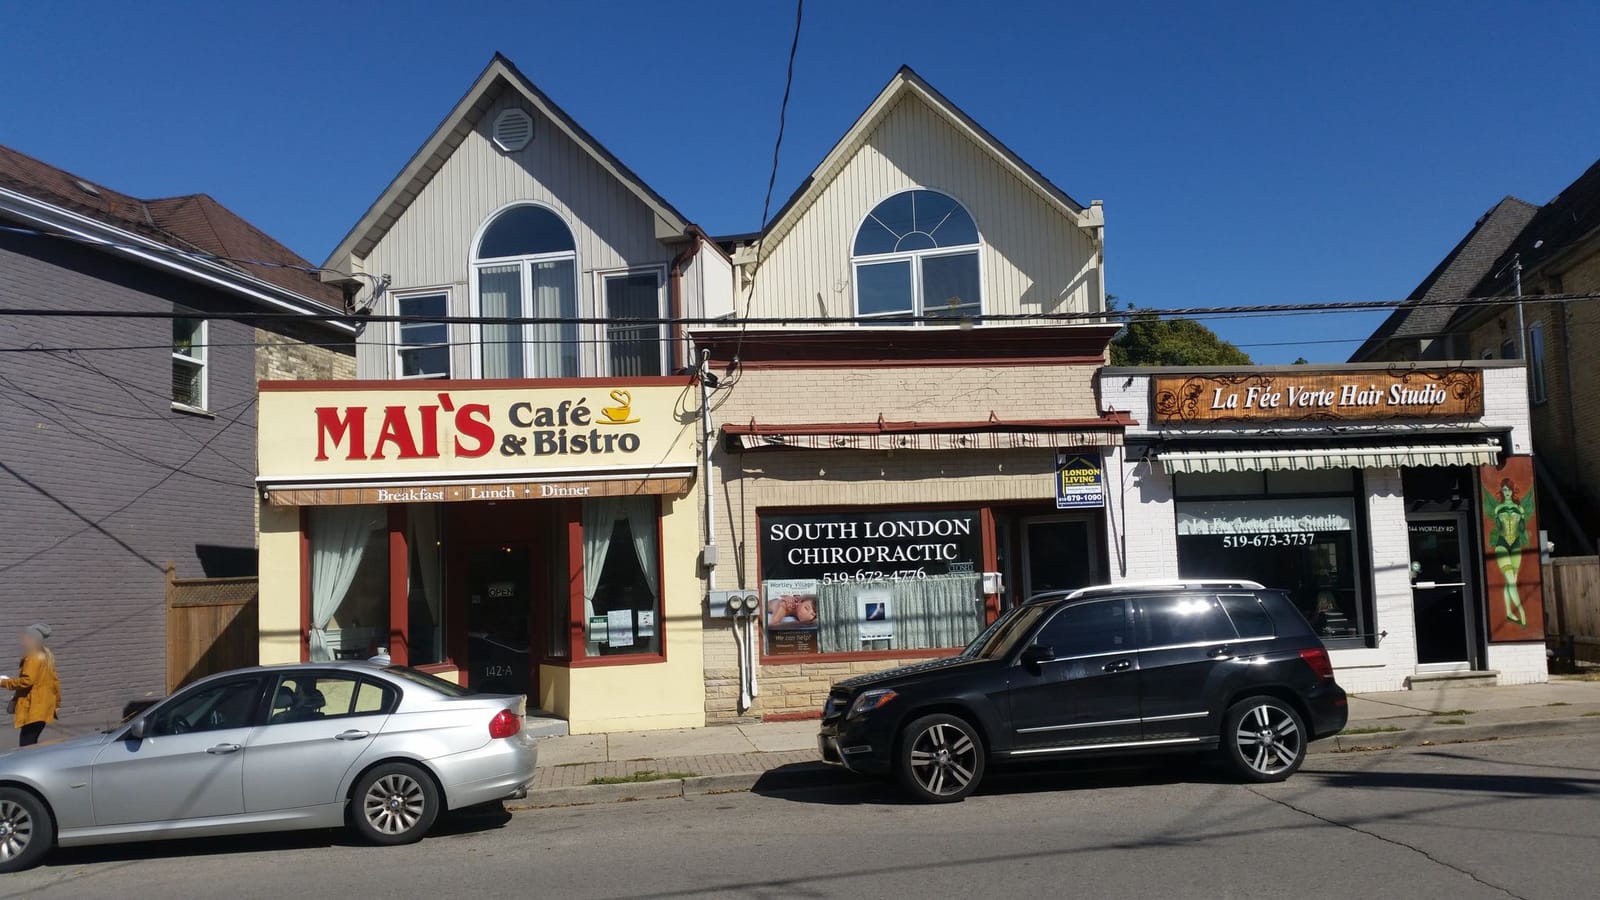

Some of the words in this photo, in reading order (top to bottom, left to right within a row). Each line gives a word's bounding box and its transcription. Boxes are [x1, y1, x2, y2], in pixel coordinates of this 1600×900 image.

[1210, 386, 1237, 410] La
[1244, 384, 1281, 409] Fée
[1286, 386, 1334, 408] Verte
[1339, 384, 1384, 406] Hair
[1387, 382, 1447, 406] Studio
[509, 397, 591, 427] Café
[500, 433, 527, 456] &
[534, 428, 640, 456] Bistro
[377, 487, 444, 502] Breakfast
[470, 486, 515, 499] Lunch
[541, 484, 590, 497] Dinner
[770, 522, 858, 541] SOUTH
[864, 519, 971, 539] LONDON
[1223, 533, 1315, 548] 519-673-3737
[788, 543, 958, 565] CHIROPRACTIC
[823, 567, 926, 585] 519-672-4776
[488, 586, 513, 597] OPEN
